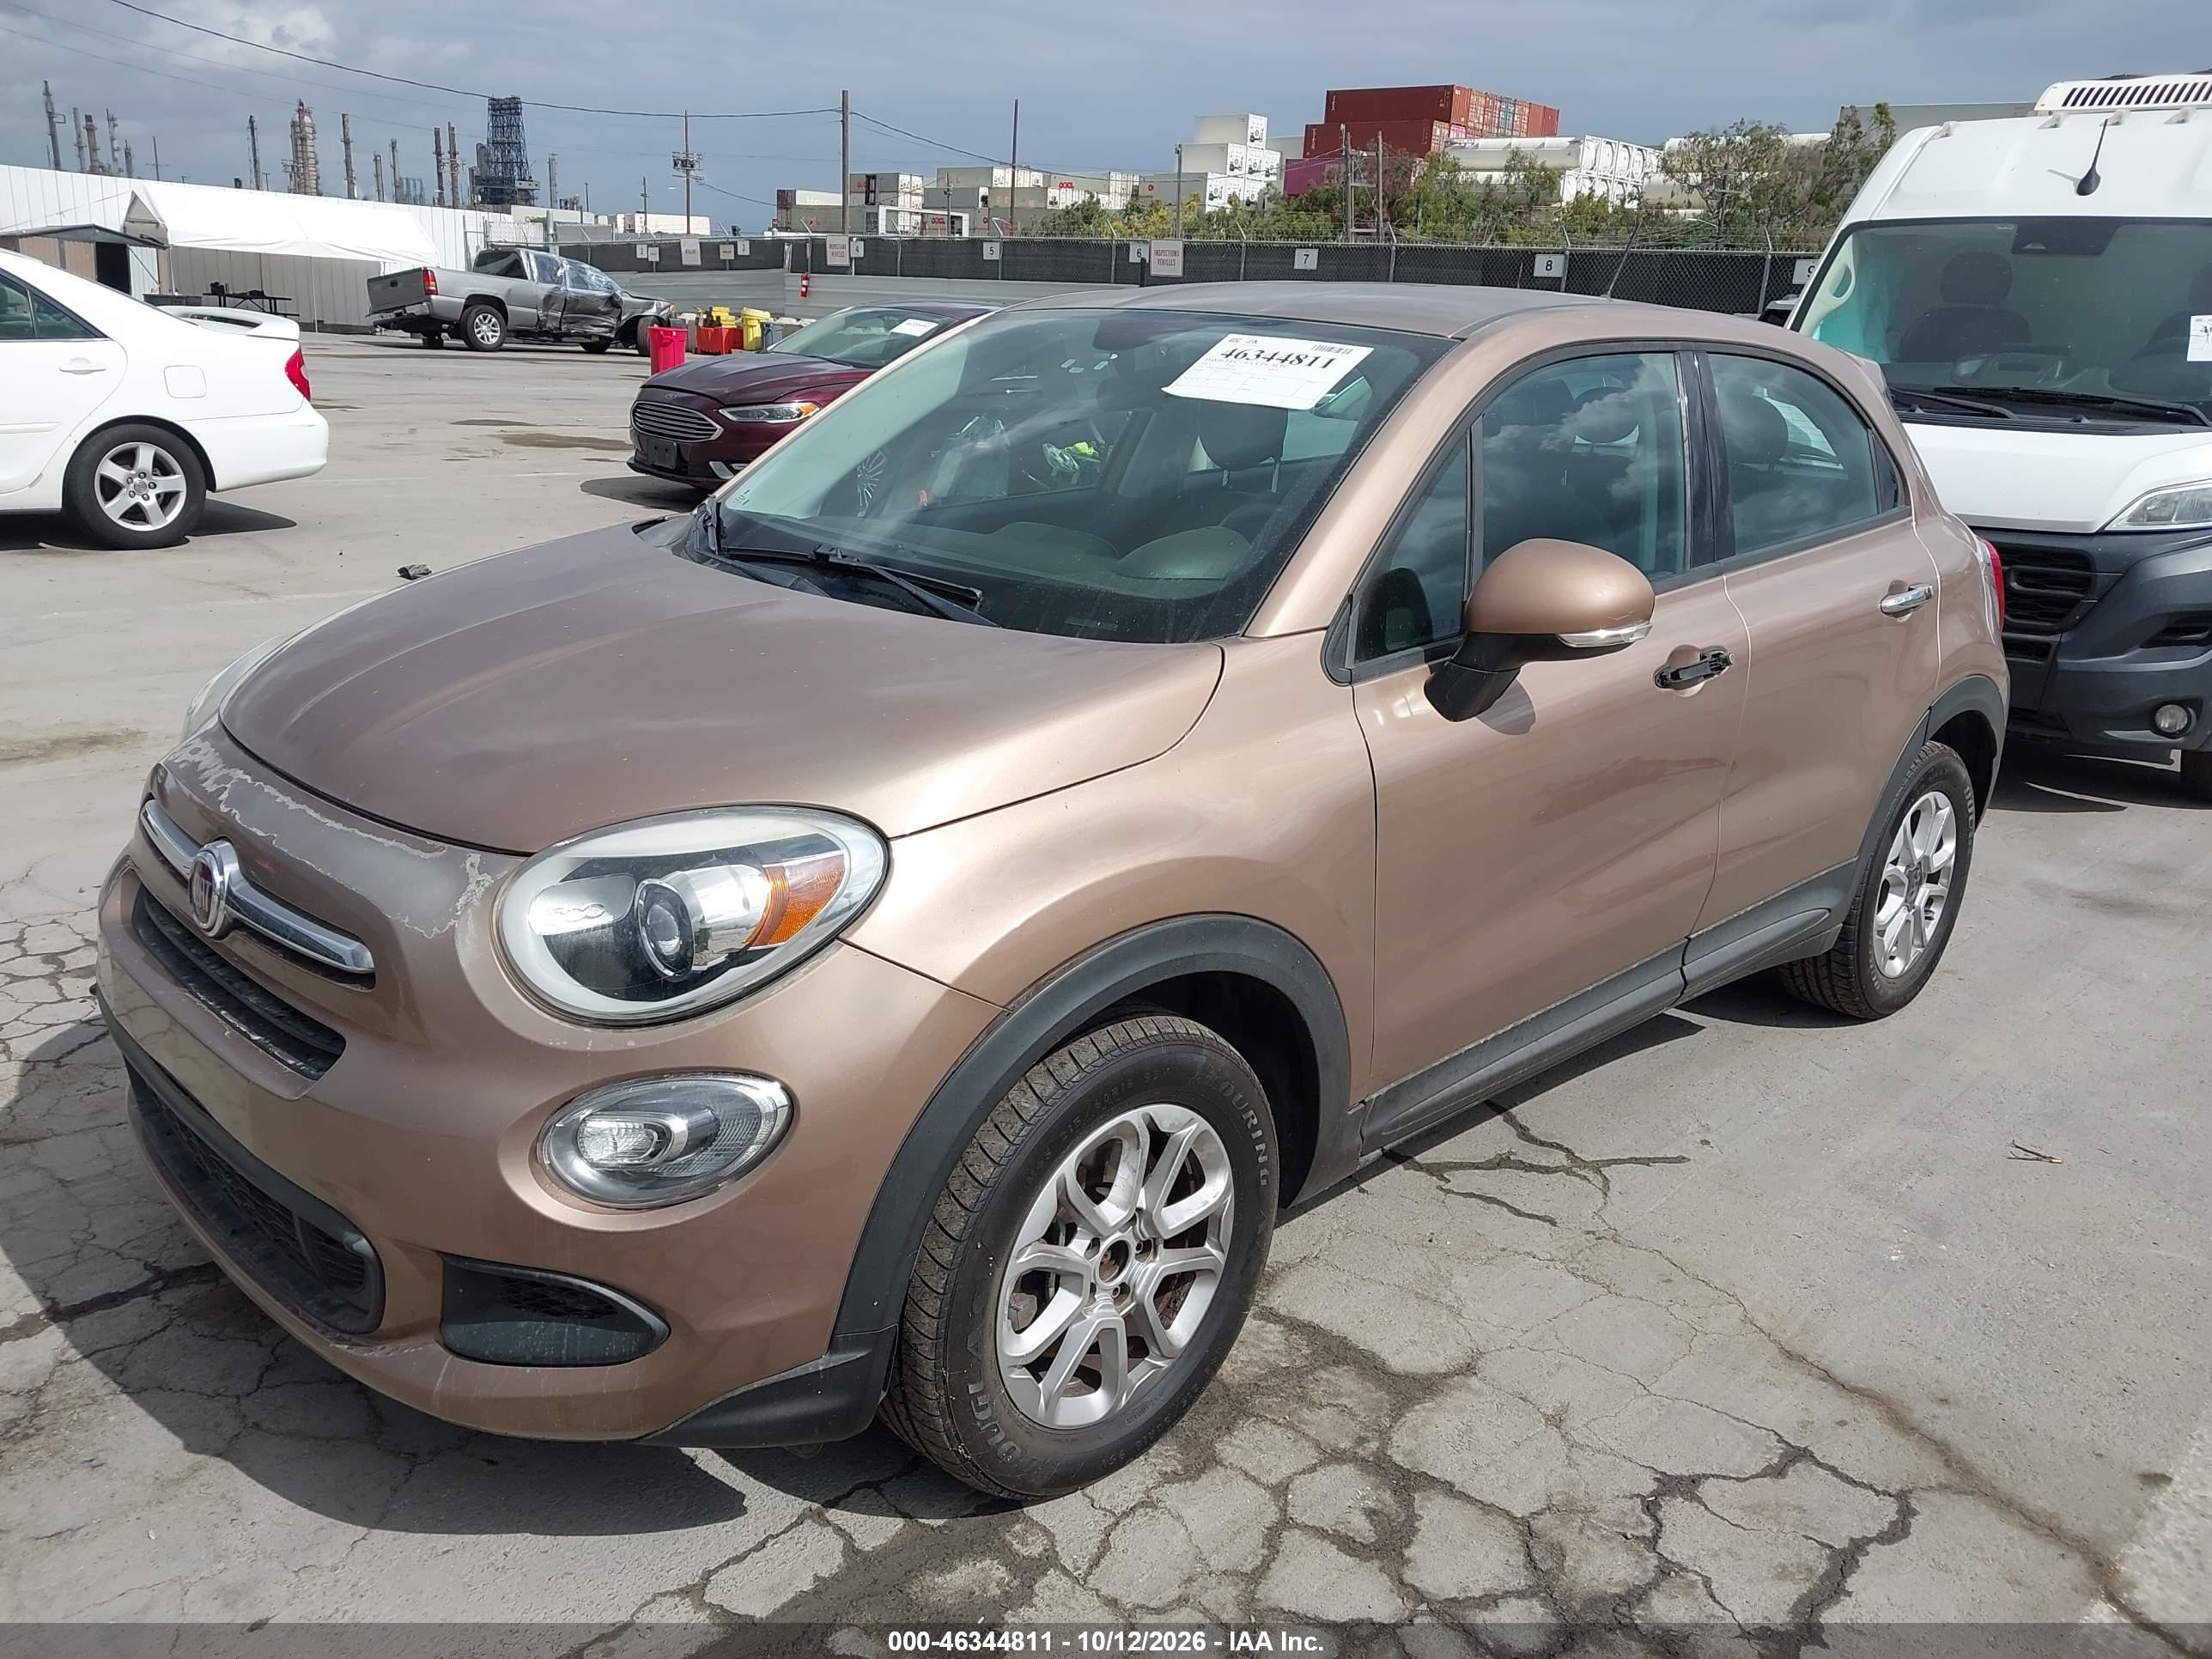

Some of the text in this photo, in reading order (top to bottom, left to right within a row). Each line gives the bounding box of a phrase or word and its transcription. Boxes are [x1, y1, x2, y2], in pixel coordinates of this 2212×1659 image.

[854, 245, 860, 253] 4
[989, 246, 994, 256] 5
[1136, 248, 1142, 258] 6
[1304, 253, 1310, 264] 7
[1545, 259, 1553, 271] 8
[1220, 347, 1336, 368] 46344811
